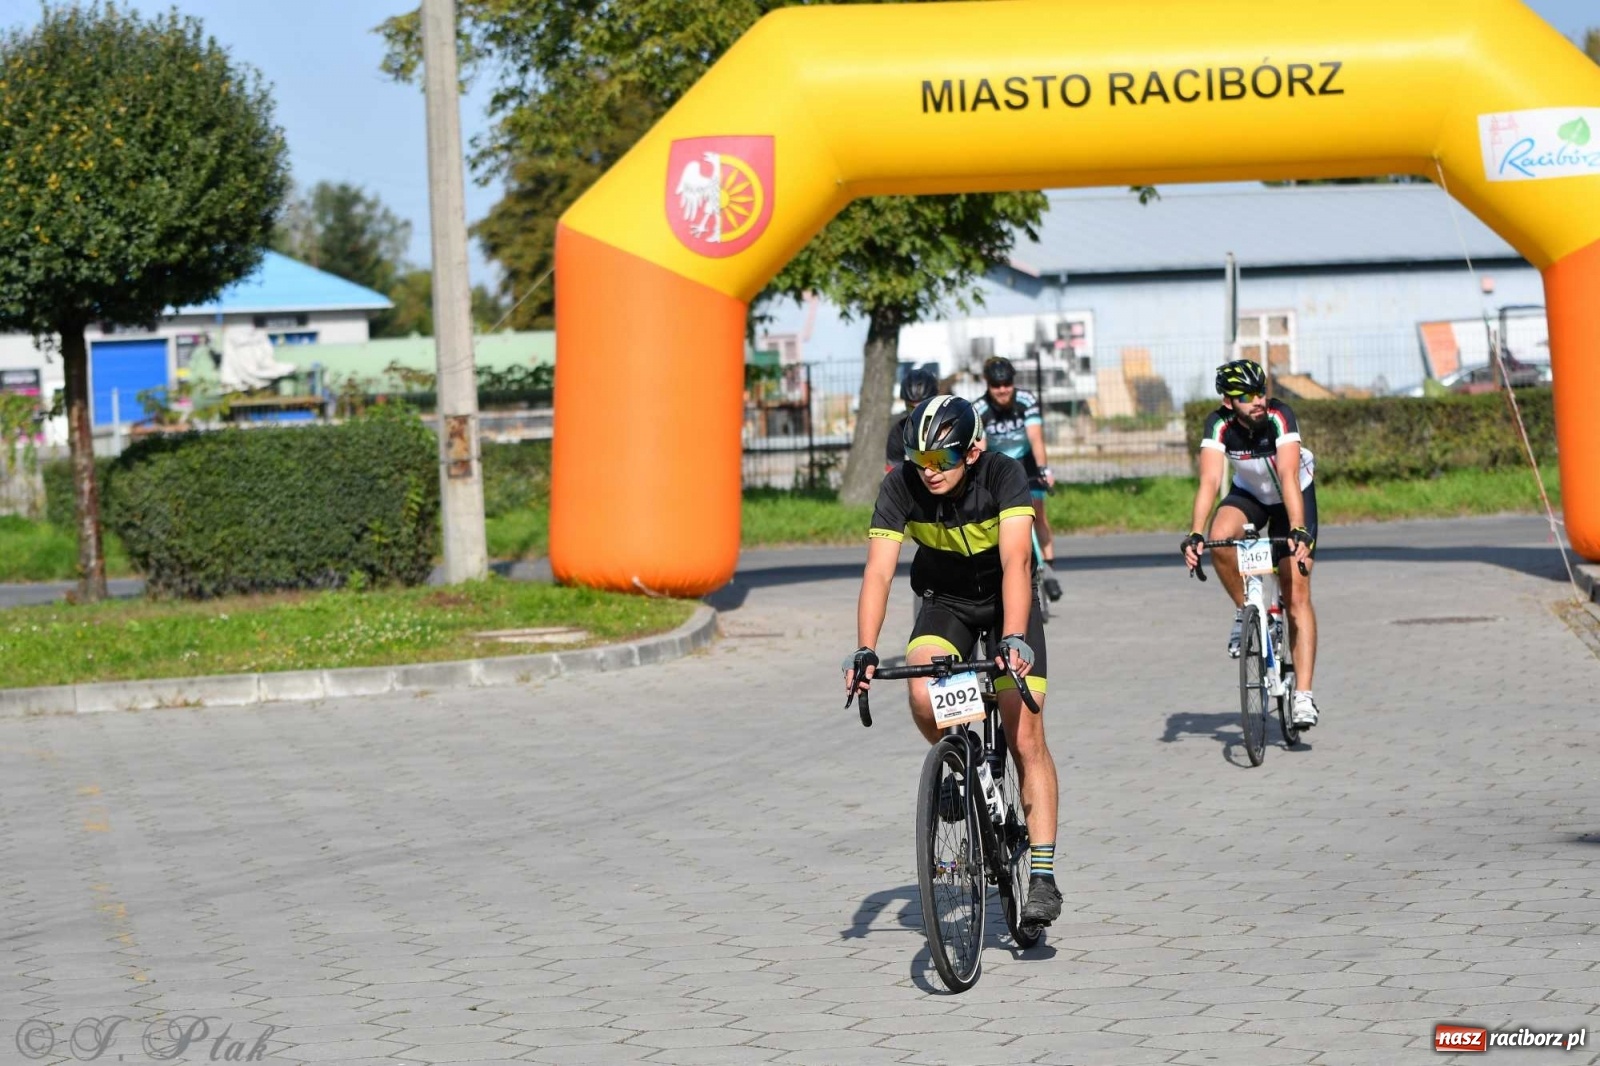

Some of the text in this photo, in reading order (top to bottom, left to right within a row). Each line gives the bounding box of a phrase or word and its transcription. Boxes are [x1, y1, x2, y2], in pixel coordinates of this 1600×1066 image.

[921, 57, 1345, 113] MIASTO RACIBÓRZ
[934, 687, 979, 710] 2092
